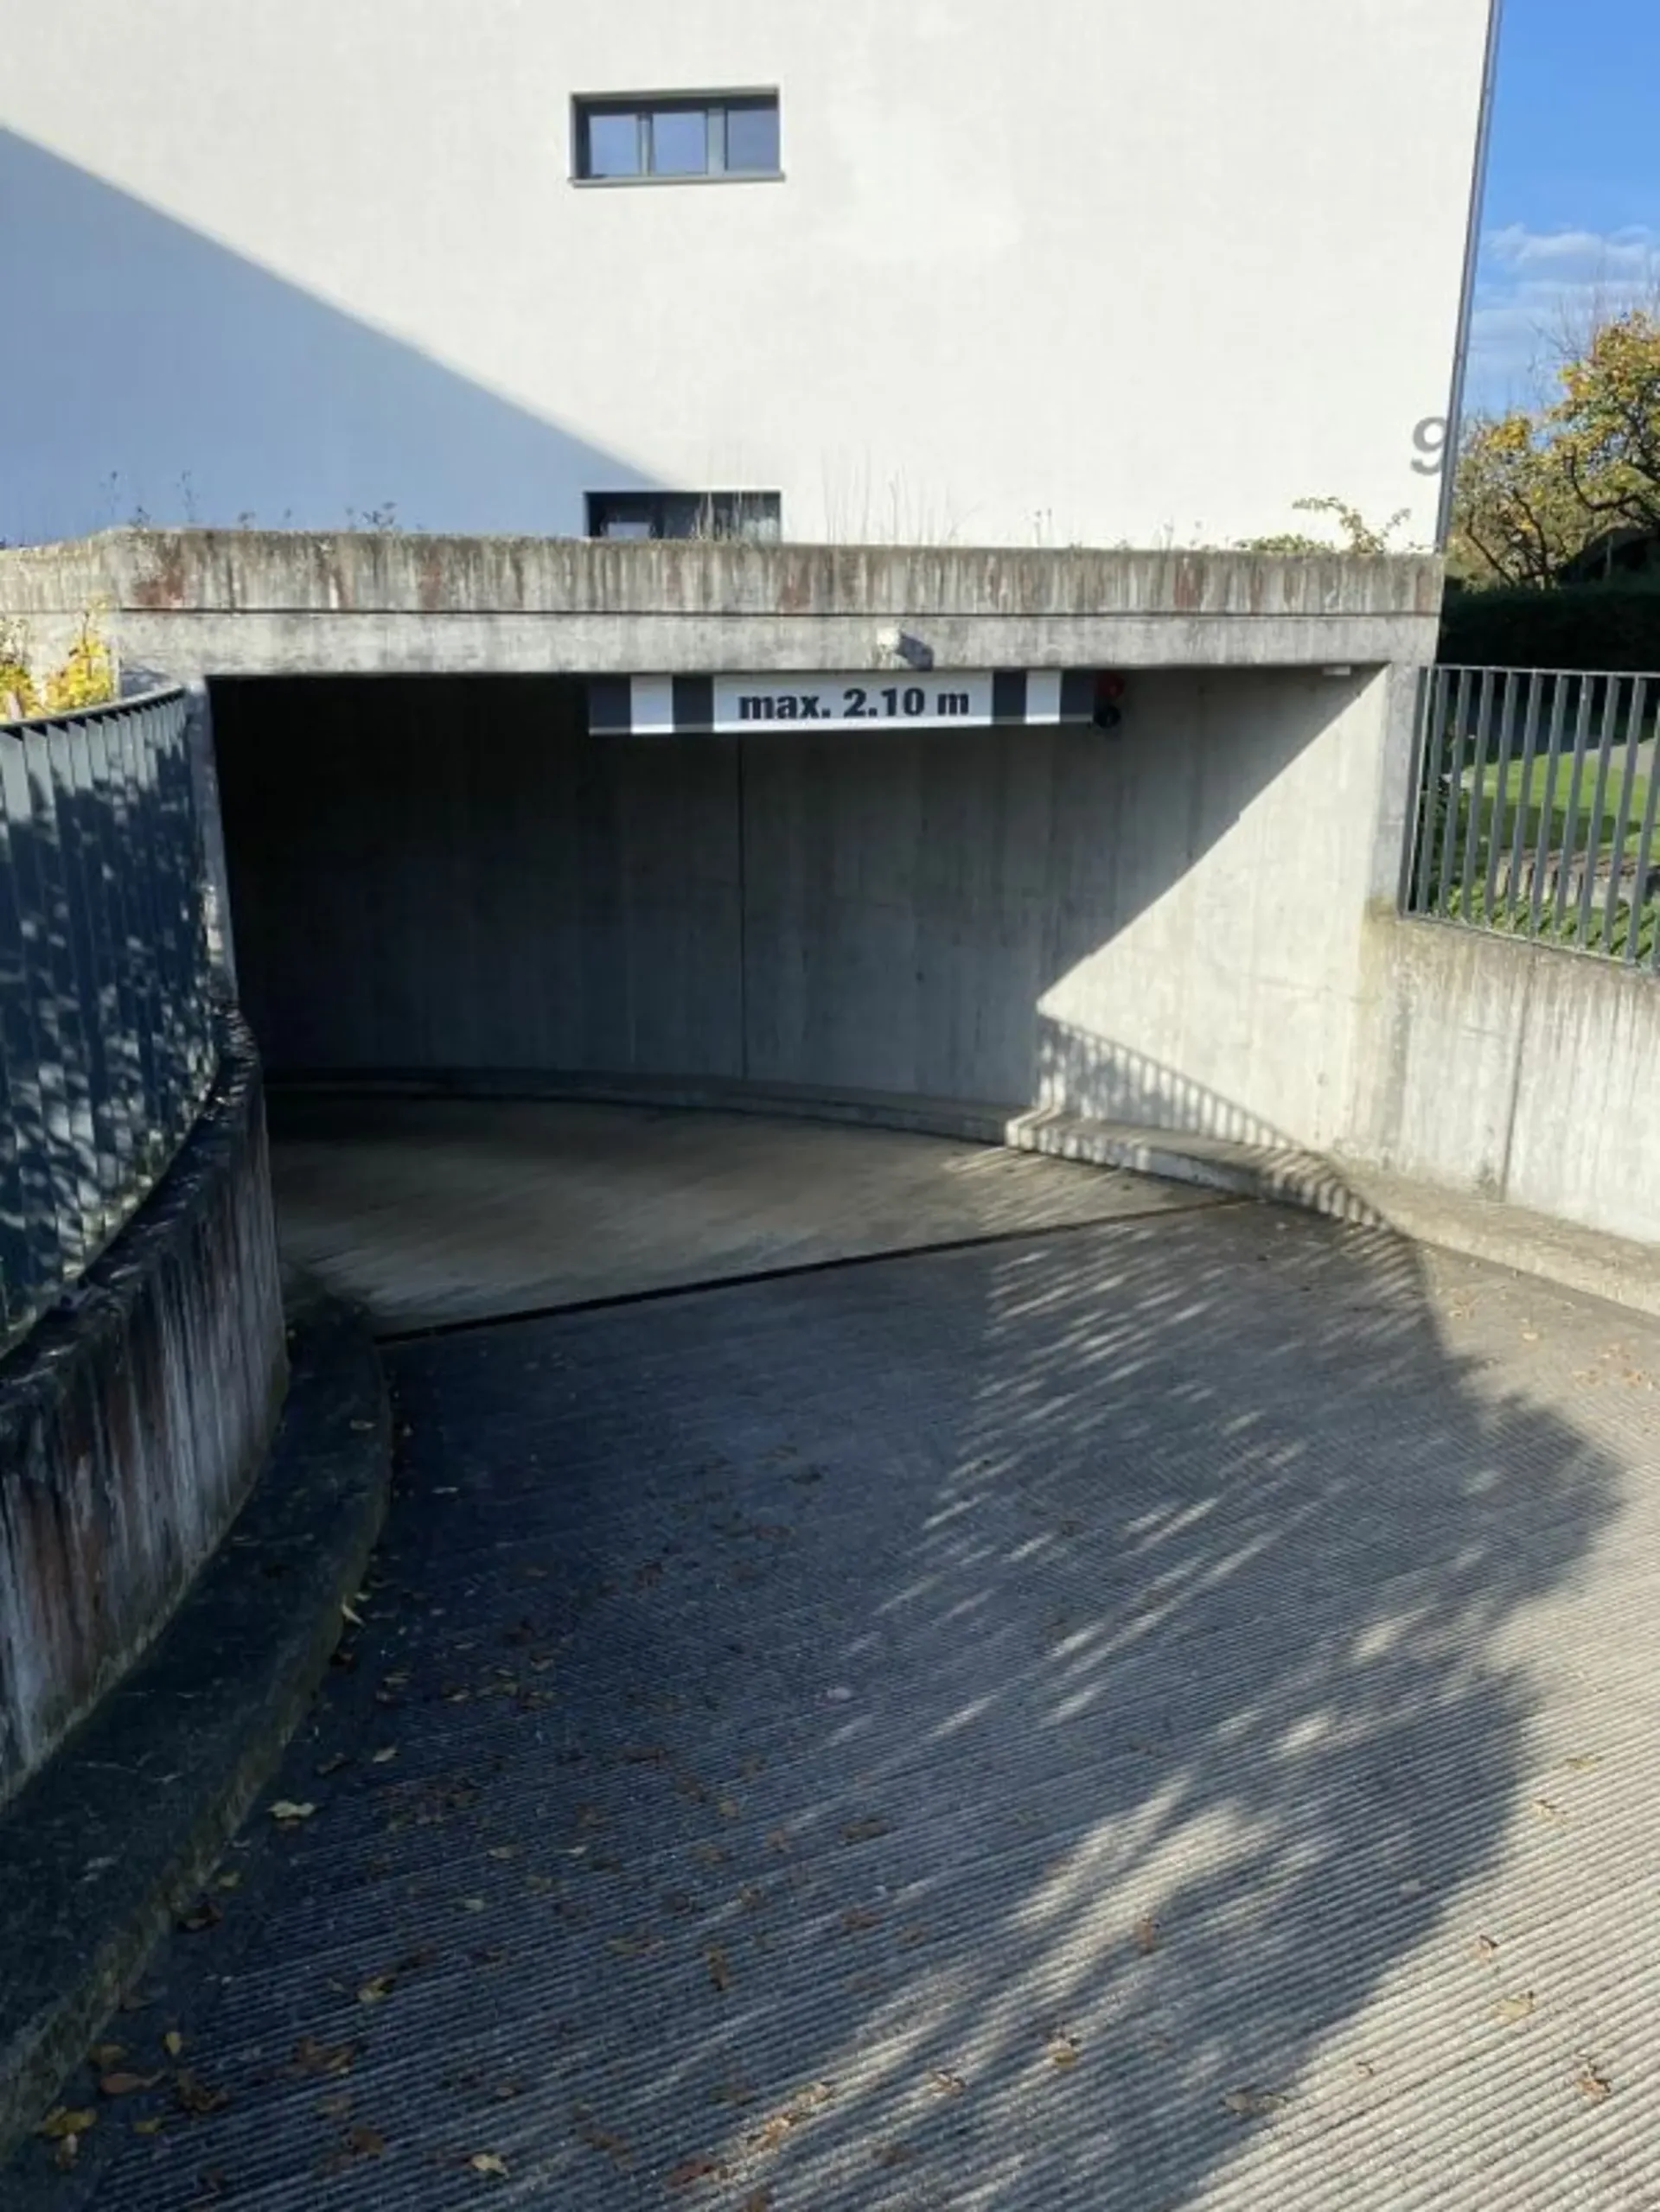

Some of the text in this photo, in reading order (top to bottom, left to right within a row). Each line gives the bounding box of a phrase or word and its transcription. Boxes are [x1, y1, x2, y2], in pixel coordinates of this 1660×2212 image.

[1410, 416, 1446, 476] 9
[738, 687, 969, 720] max. 2.10 m
